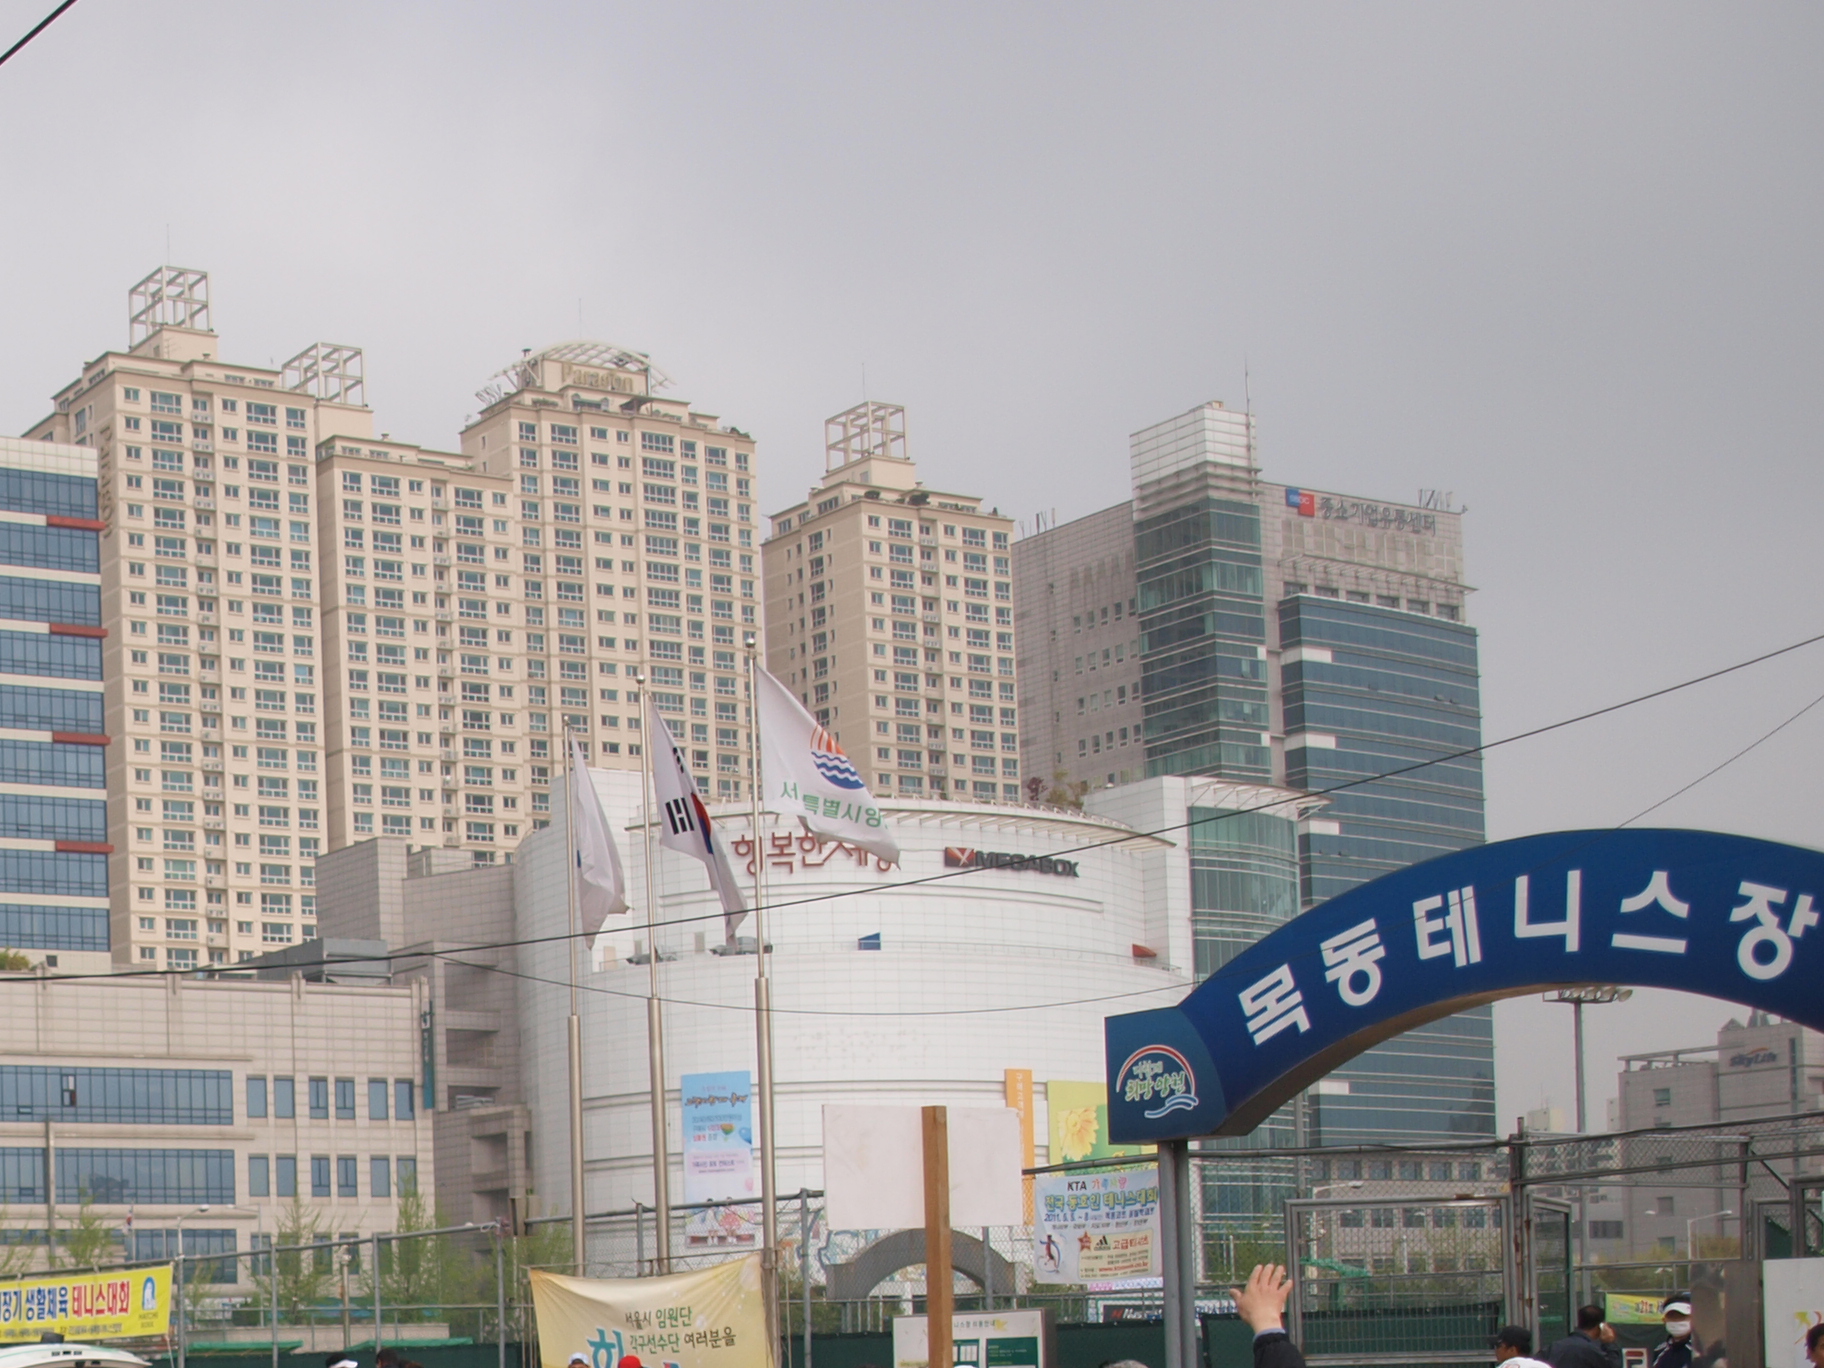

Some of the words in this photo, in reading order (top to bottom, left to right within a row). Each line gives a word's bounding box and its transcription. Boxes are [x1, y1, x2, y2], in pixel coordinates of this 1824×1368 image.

[1319, 496, 1436, 536] 중소기업유통센터
[976, 849, 1080, 879] MEGABOX
[1237, 869, 1821, 1046] 목동테니스장
[1067, 1181, 1087, 1191] KTA
[1045, 1194, 1065, 1212] 전국
[1067, 1193, 1101, 1211] 동호인
[25, 1286, 69, 1321] 생활체육
[72, 1281, 131, 1318] 테니스대회
[655, 1306, 692, 1328] 임원단
[629, 1333, 680, 1355] 각구선수단
[684, 1326, 737, 1349] 여러분을
